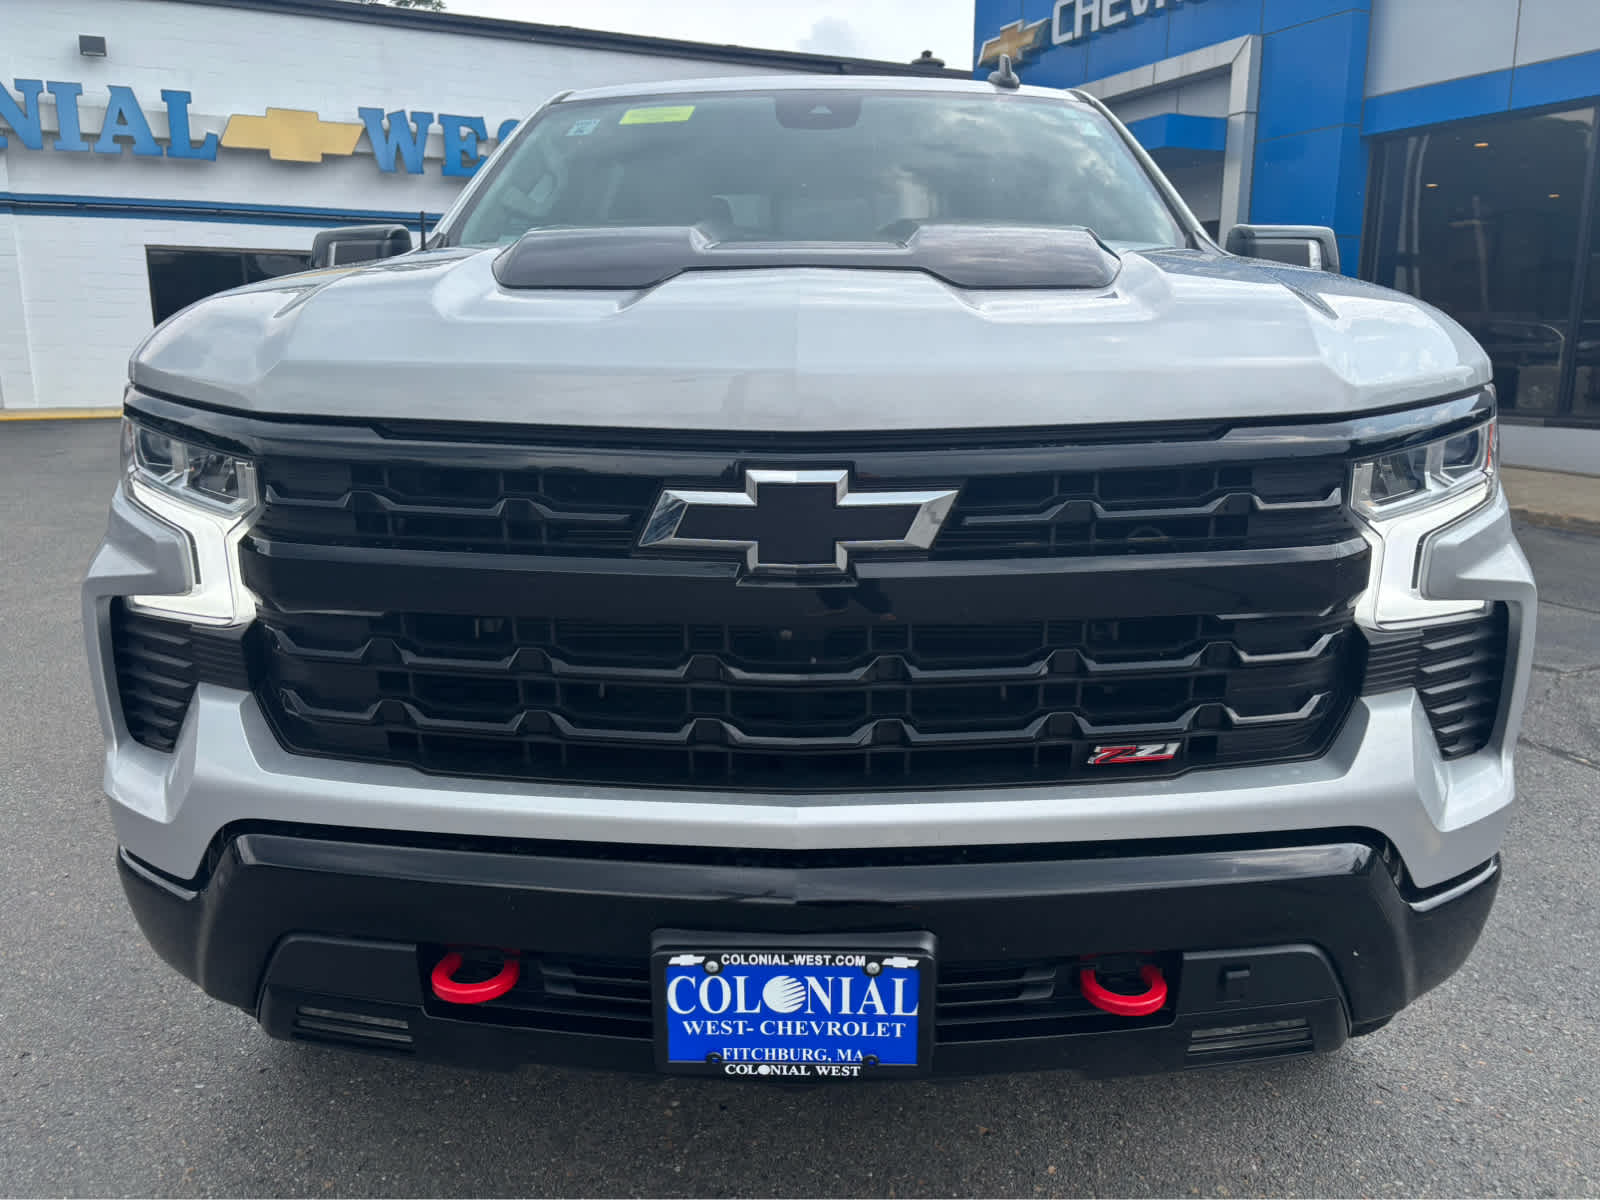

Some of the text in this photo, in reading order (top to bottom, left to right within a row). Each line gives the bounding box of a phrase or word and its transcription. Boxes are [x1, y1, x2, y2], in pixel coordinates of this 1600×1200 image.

[1087, 743, 1181, 765] Z71
[720, 954, 866, 967] COLONIAL-WEST.COM
[667, 975, 919, 1016] COLONIAL
[682, 1021, 907, 1038] WEST- CHEVROLET
[722, 1048, 863, 1062] FITCHBURG, MA
[724, 1064, 861, 1077] COLONIAL WEST
